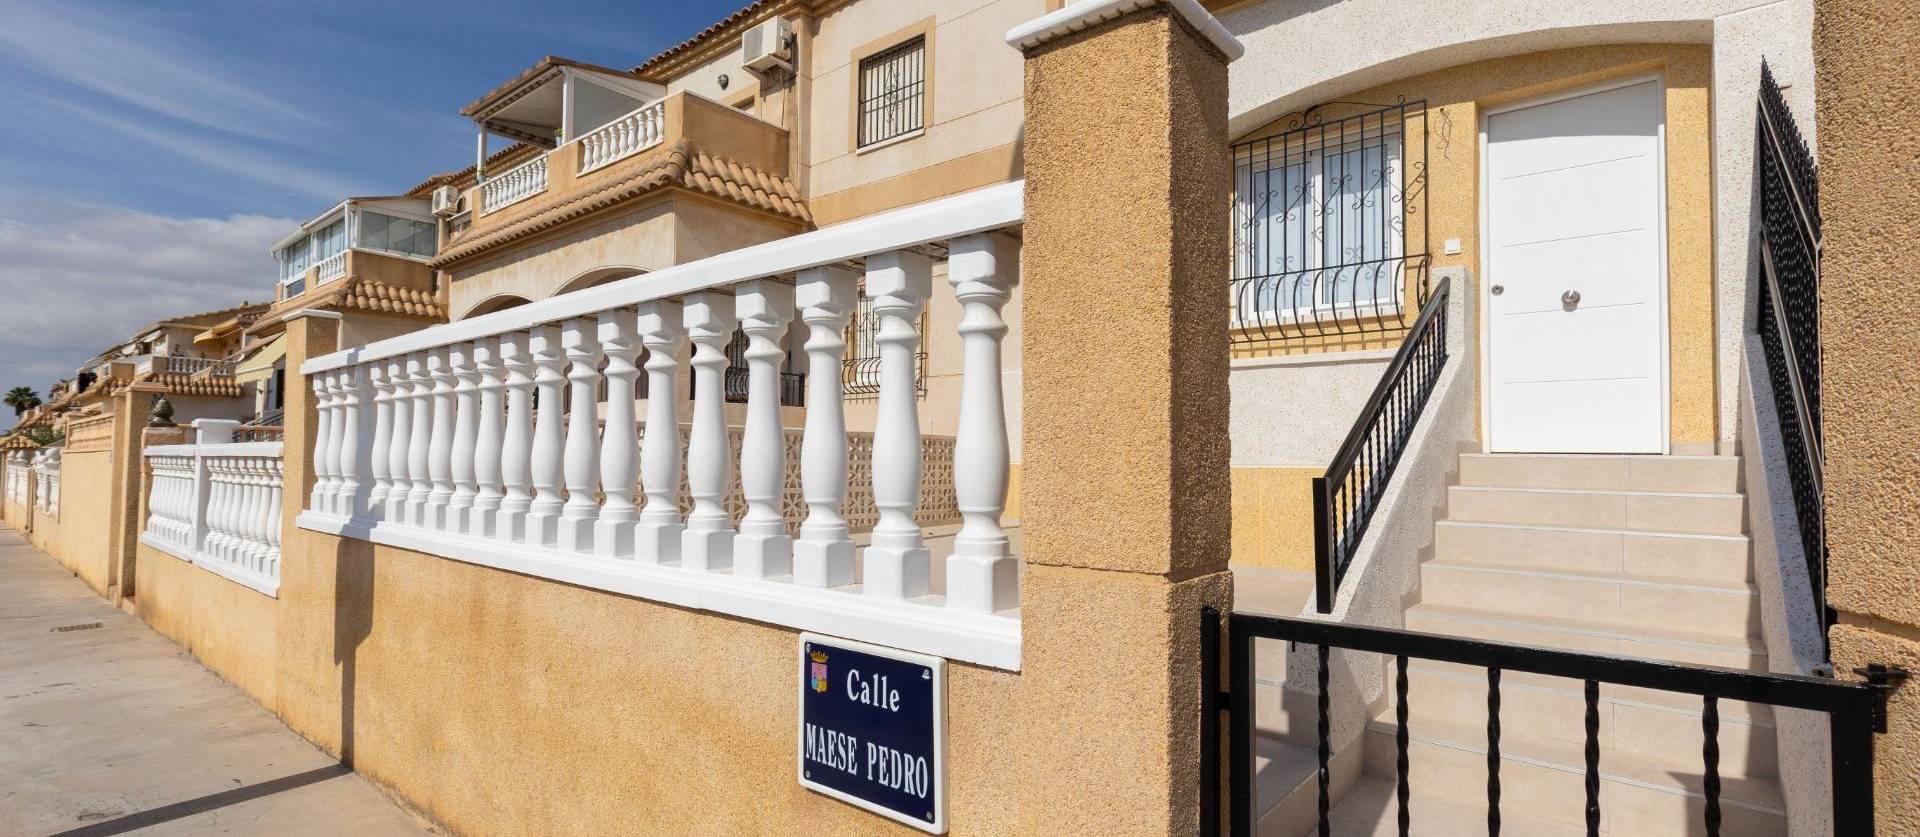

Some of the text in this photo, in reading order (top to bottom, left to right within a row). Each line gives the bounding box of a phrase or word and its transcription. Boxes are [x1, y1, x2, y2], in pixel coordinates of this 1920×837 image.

[847, 669, 900, 712] Calle
[805, 723, 928, 799] MAESE PEDRO
